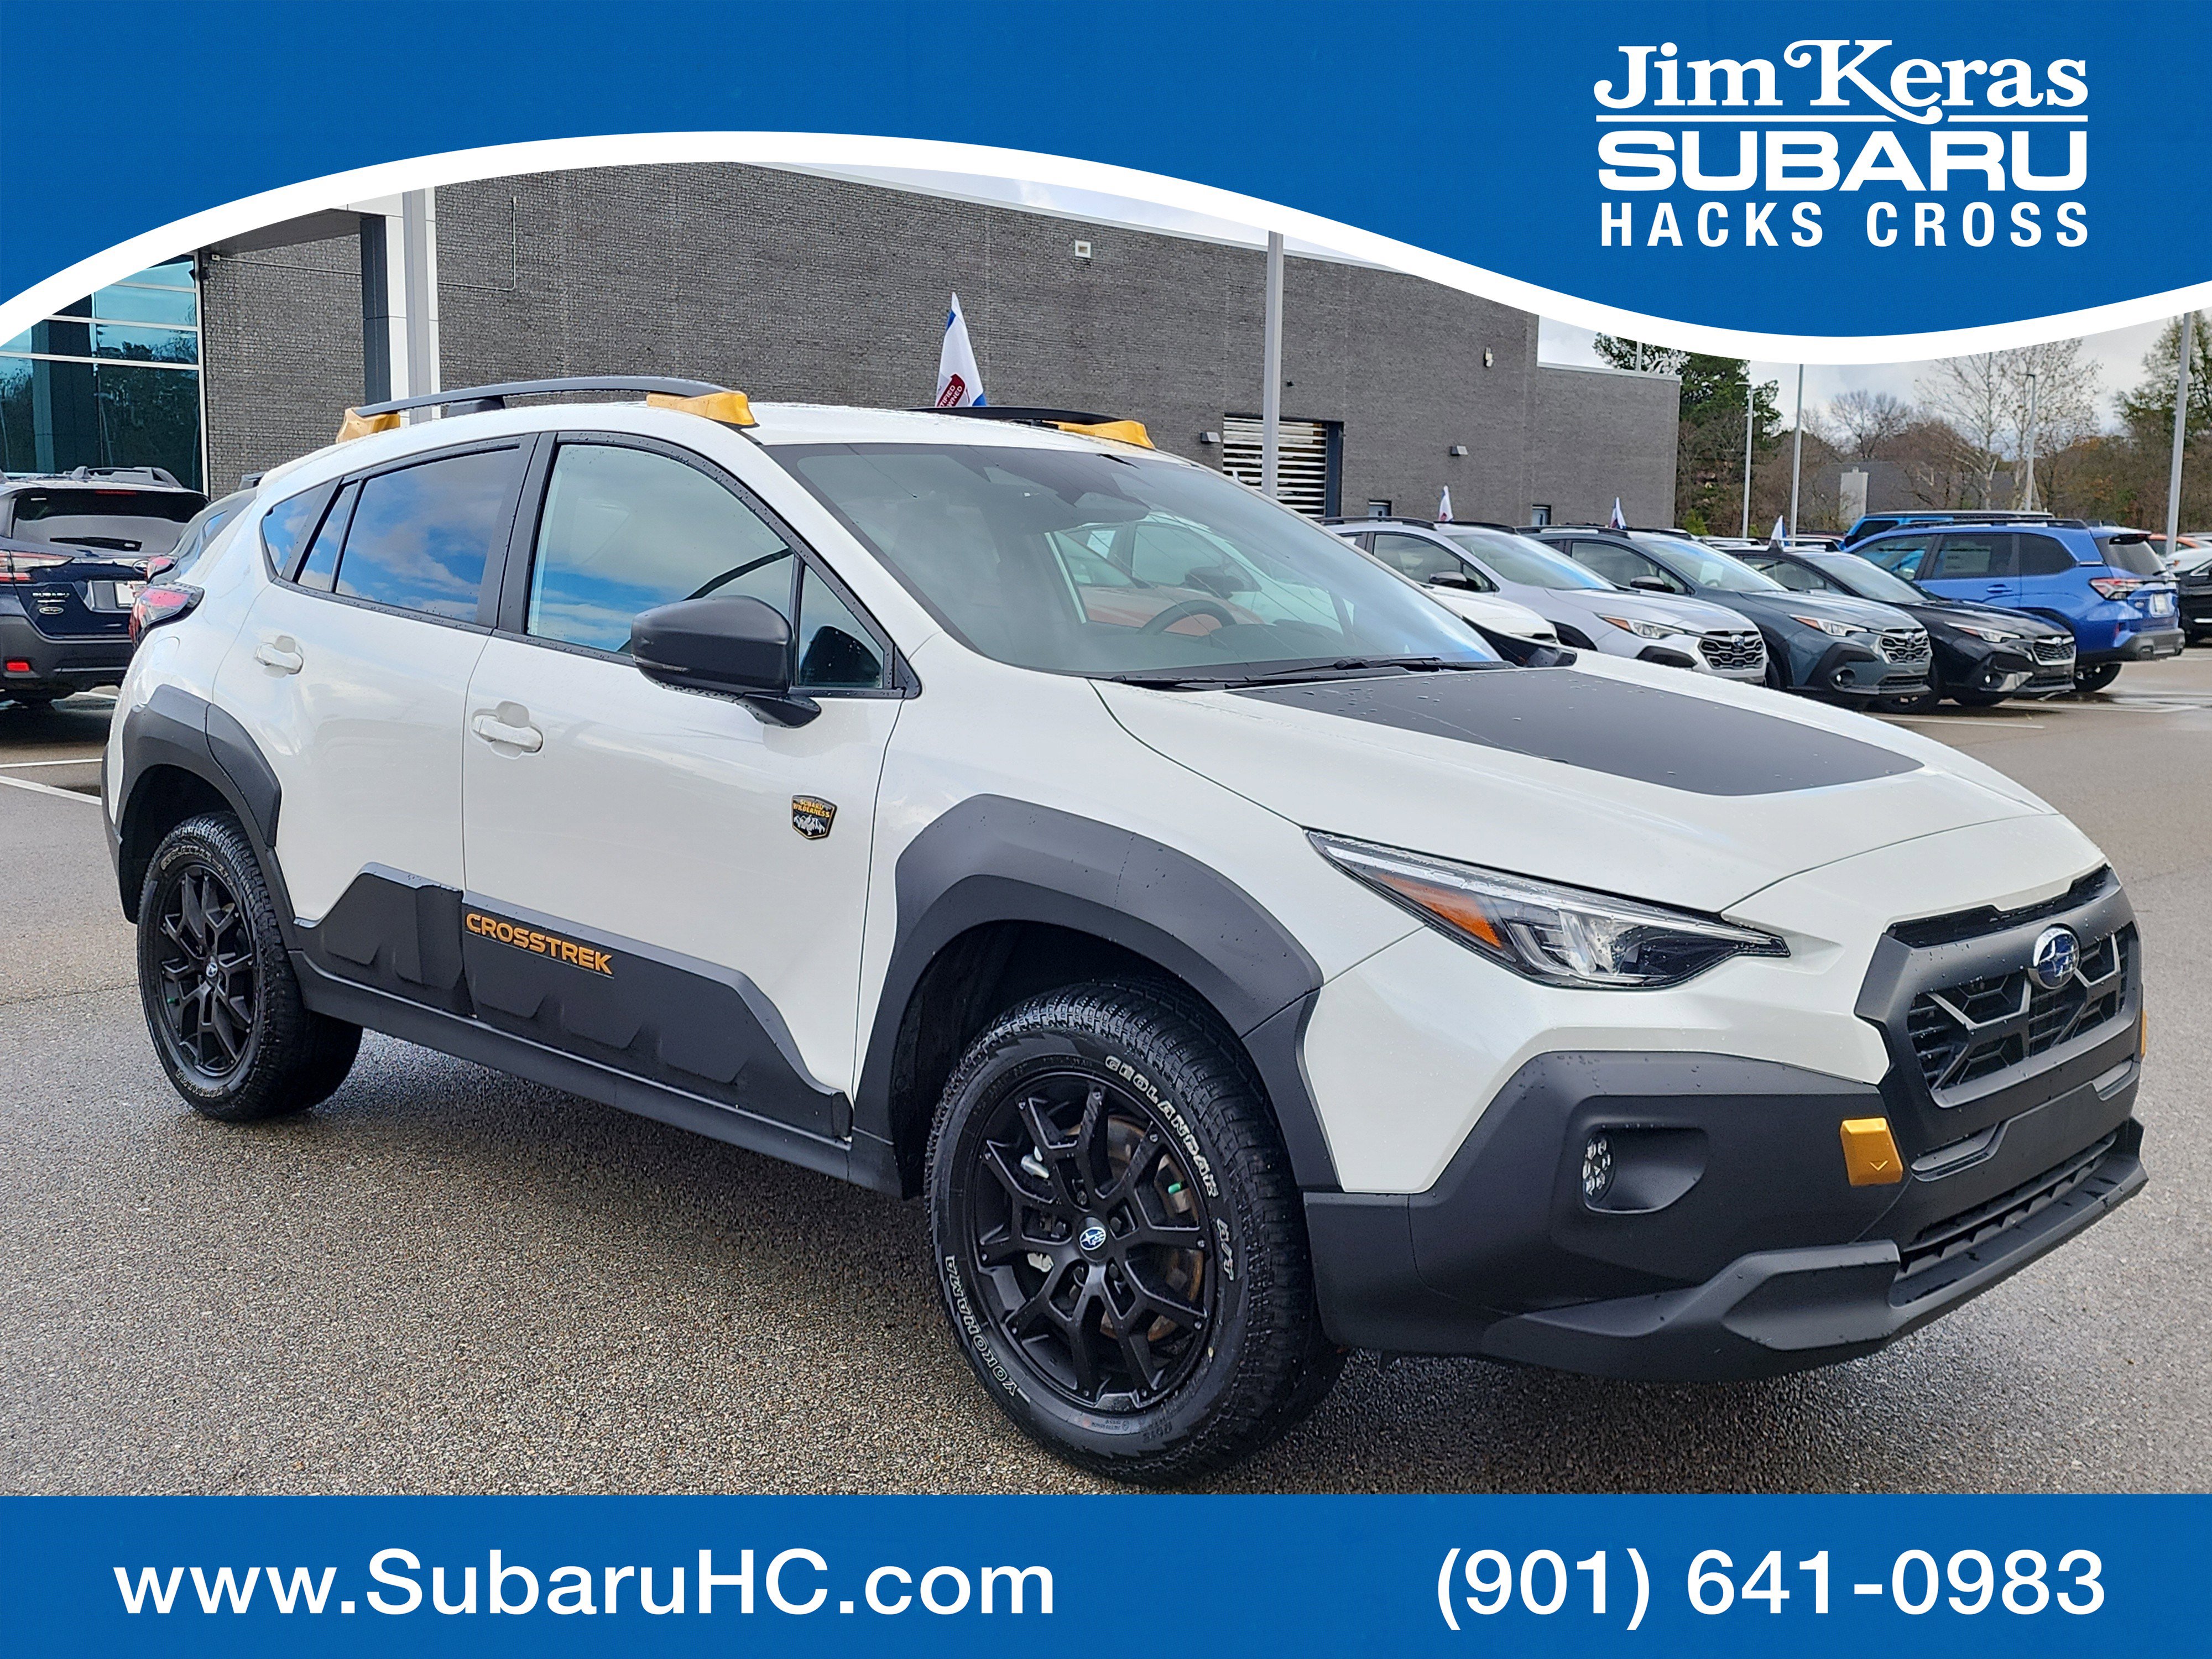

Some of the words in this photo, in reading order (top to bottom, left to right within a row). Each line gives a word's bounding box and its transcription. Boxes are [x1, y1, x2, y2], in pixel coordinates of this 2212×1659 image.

[466, 913, 613, 975] CROSSTREK
[1105, 1055, 1219, 1198] GEOLANDAR
[945, 1255, 1018, 1397] YOKOHAMA
